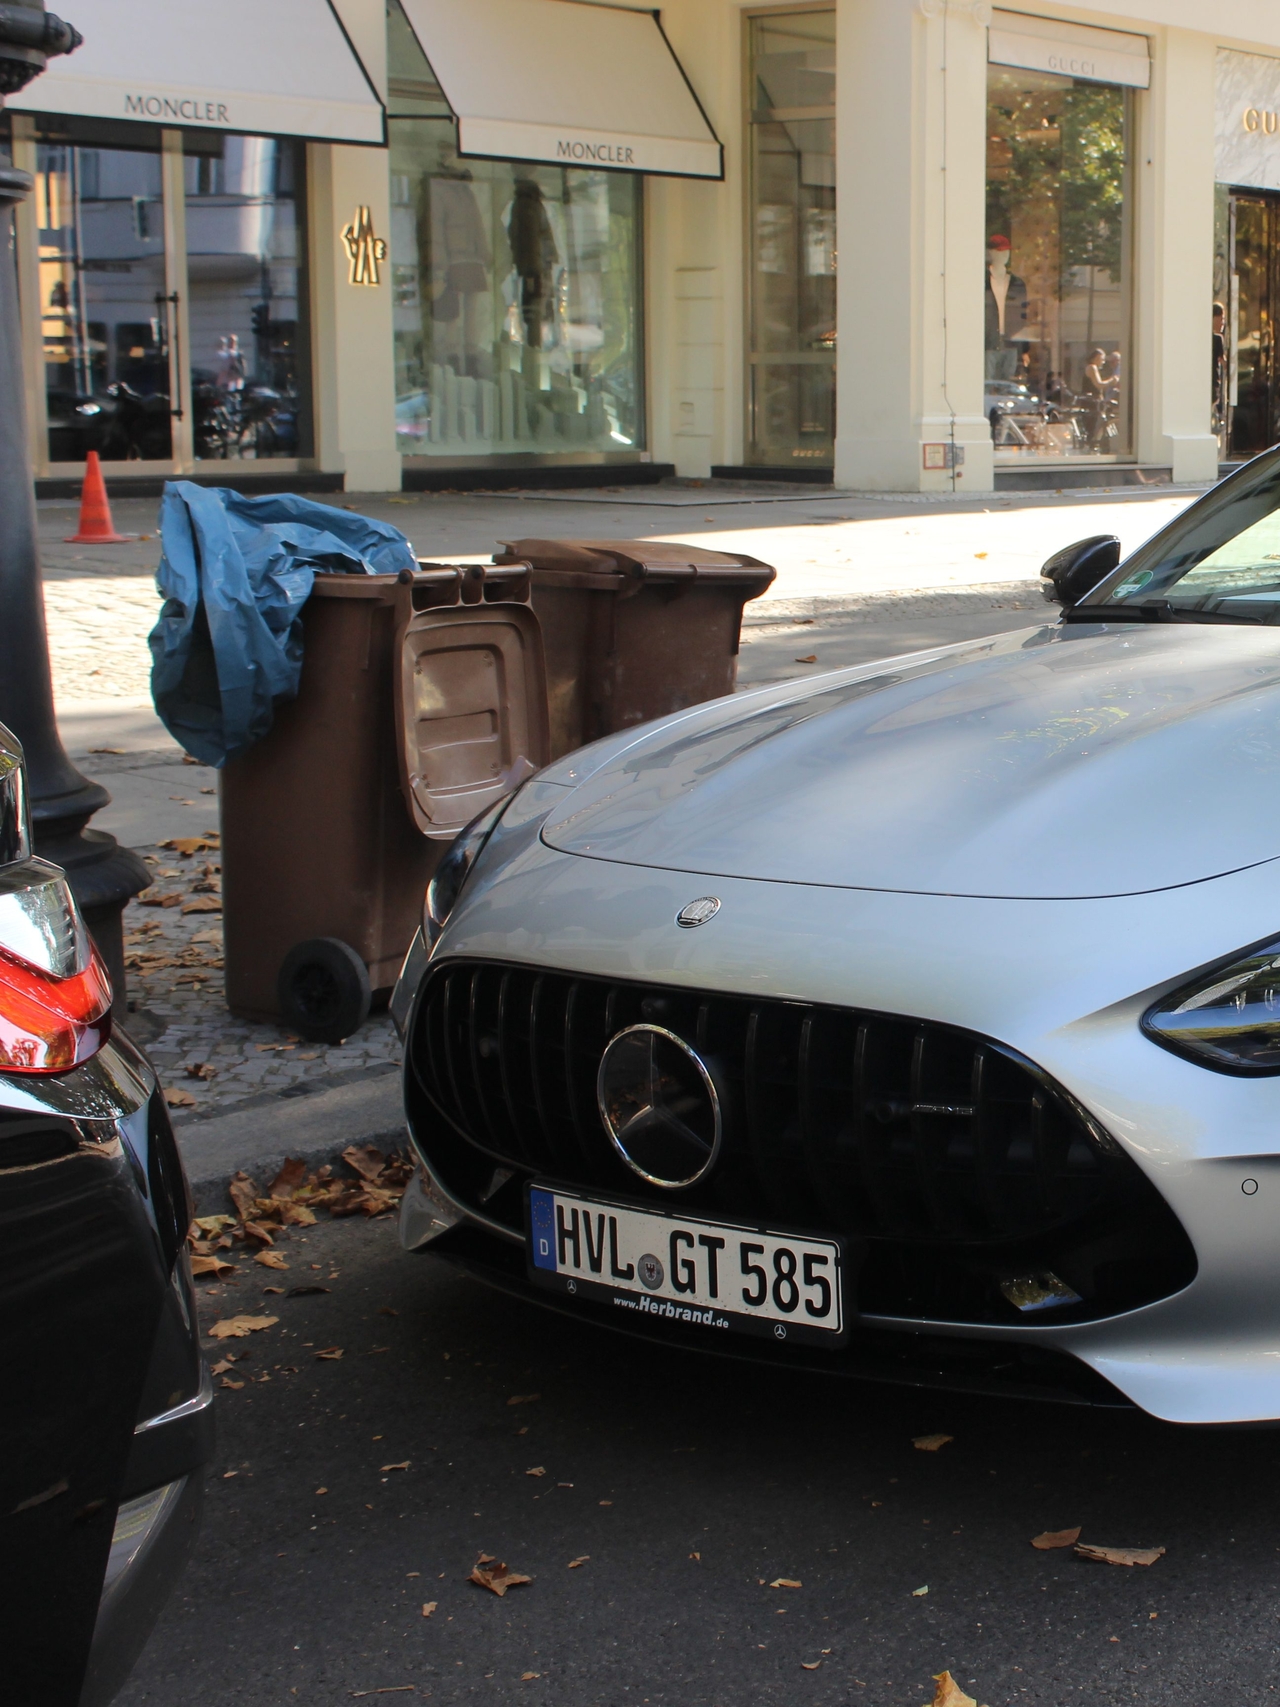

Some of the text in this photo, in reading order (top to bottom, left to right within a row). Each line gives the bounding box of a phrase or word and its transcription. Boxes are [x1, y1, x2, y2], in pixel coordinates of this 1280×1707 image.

[1048, 55, 1095, 75] GUCCI
[124, 94, 231, 123] MONCLER
[556, 141, 634, 163] MONCLER
[540, 1238, 549, 1256] D
[556, 1204, 831, 1318] HVL GT 585
[613, 1296, 729, 1329] www.Herbrand.de
